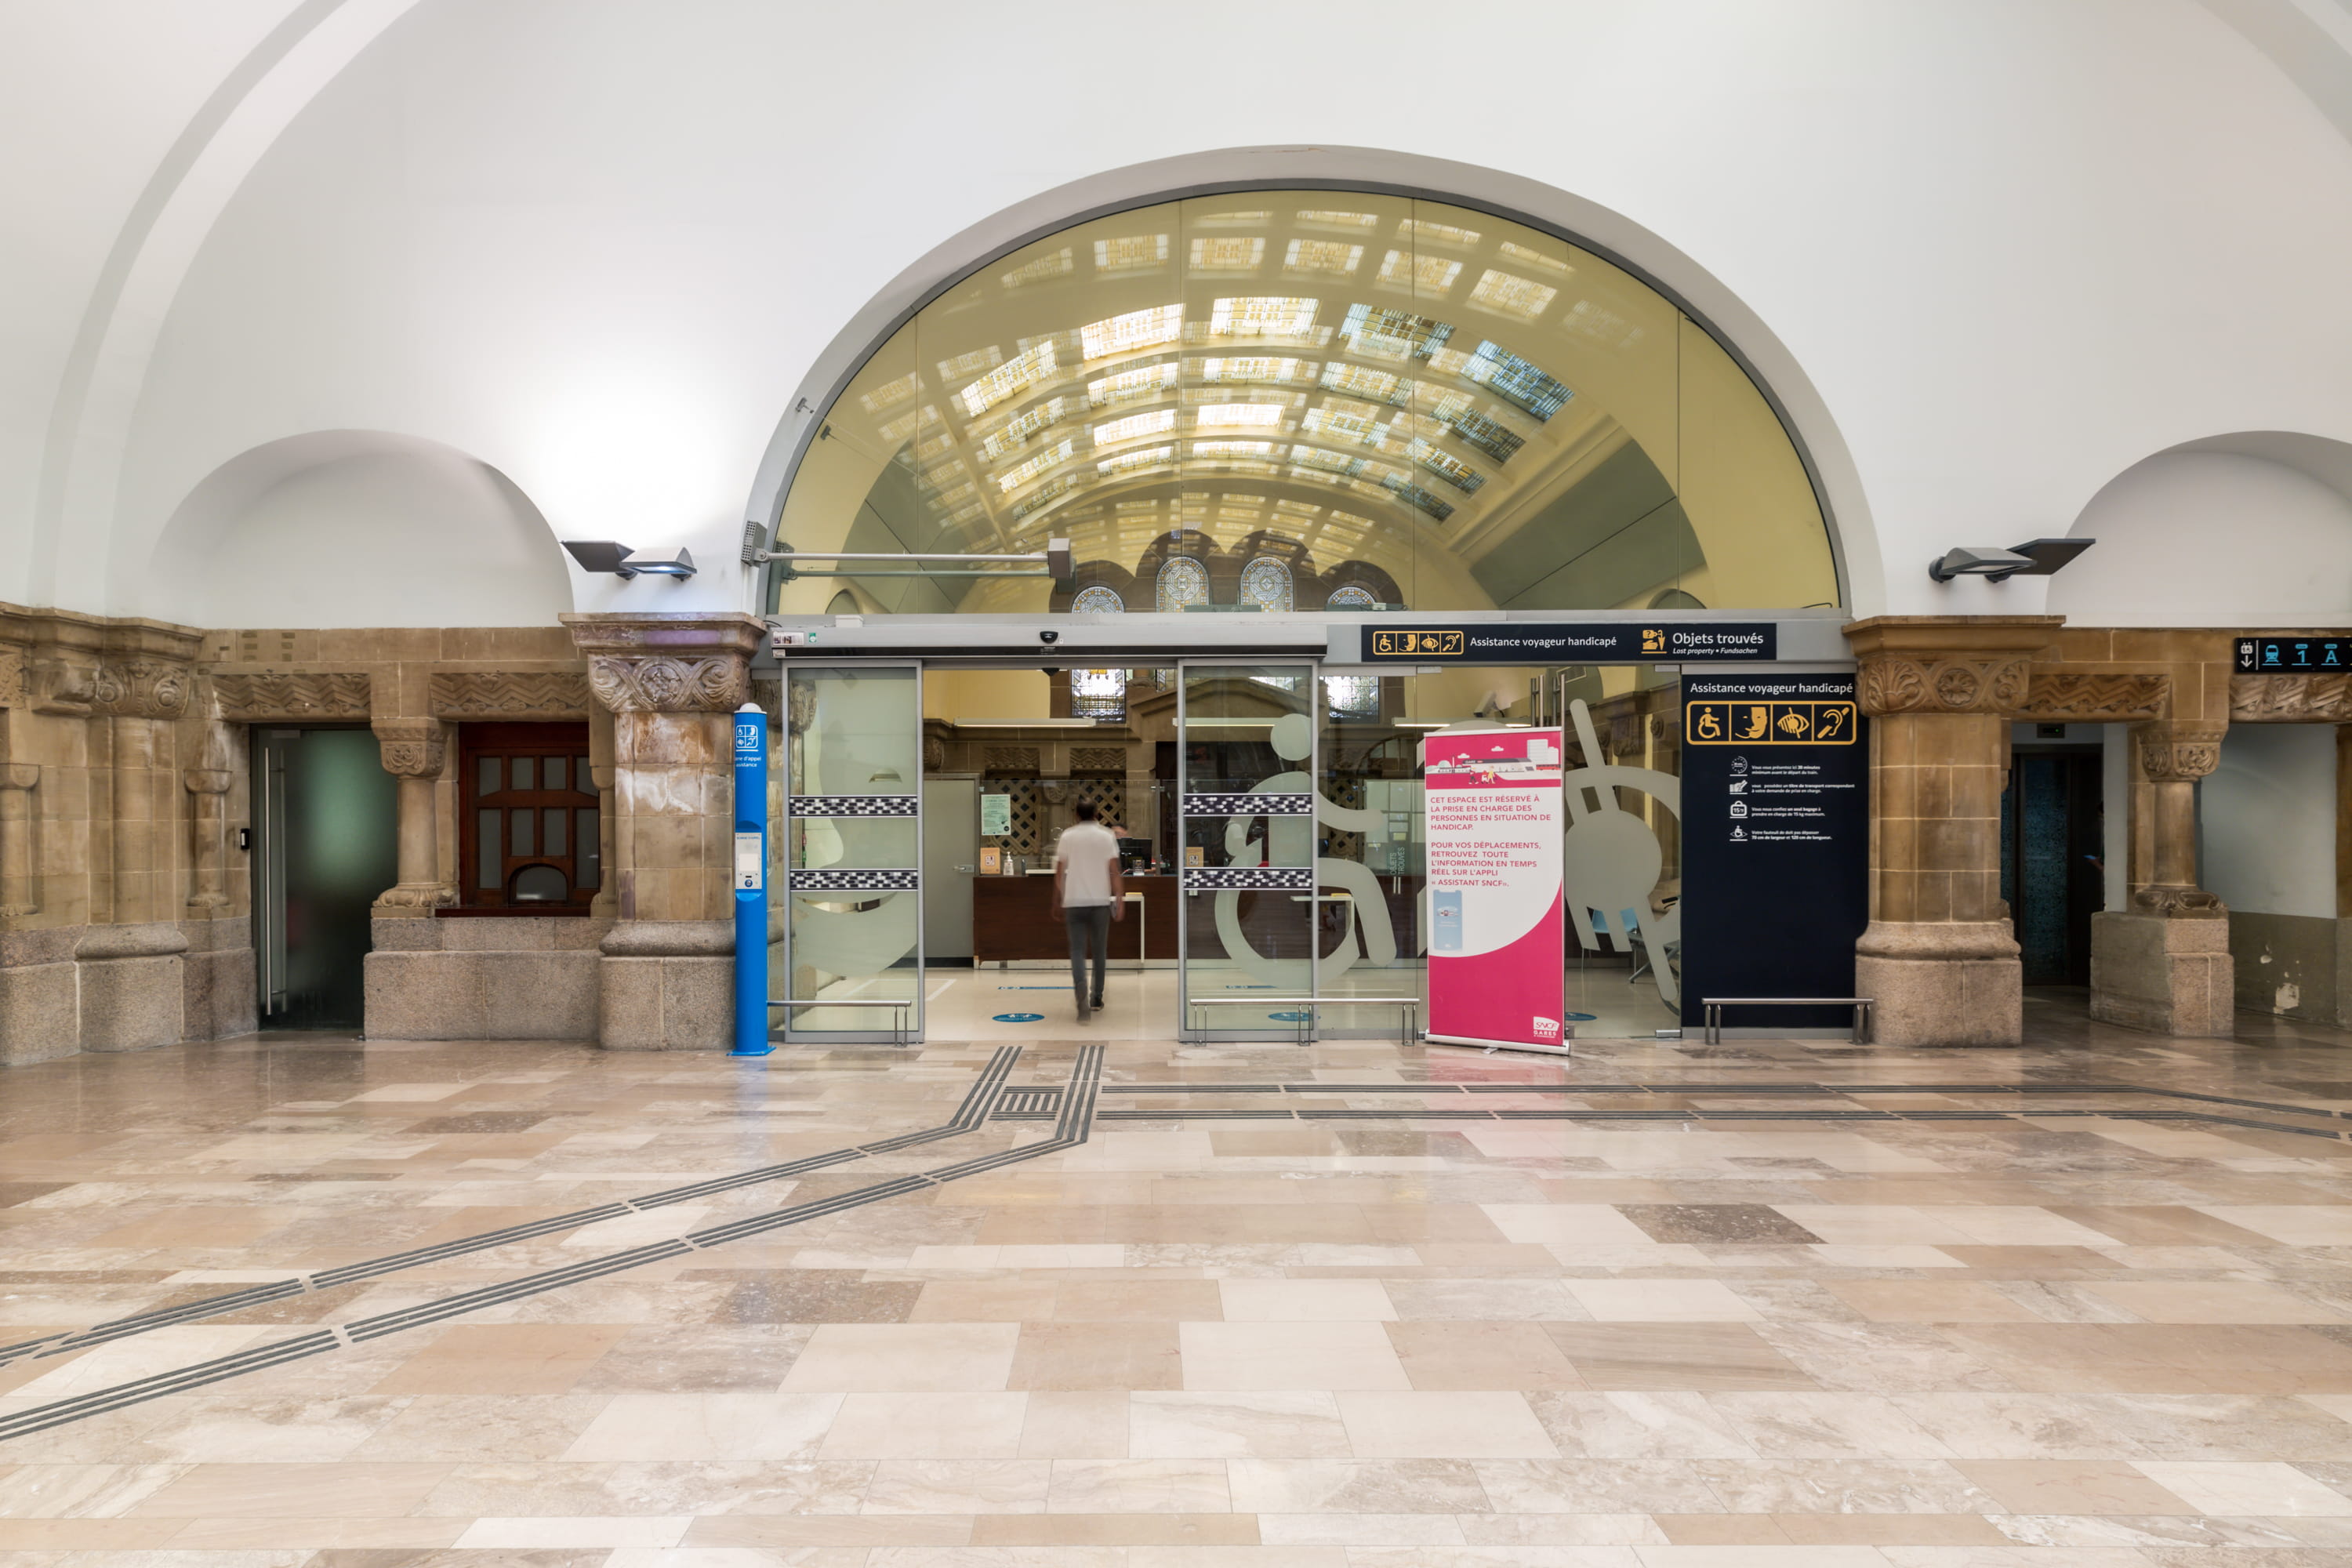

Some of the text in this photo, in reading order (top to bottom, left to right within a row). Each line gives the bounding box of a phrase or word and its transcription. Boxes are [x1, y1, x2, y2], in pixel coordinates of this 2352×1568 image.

[1470, 637, 1617, 648] Assistance voyageur handicapé
[1673, 633, 1763, 646] Objets trouvés
[2297, 650, 2337, 662] 1 A
[1690, 683, 1853, 695] Assistance voyageur handicapé
[1474, 841, 1541, 850] DÉPLACEMENTS,
